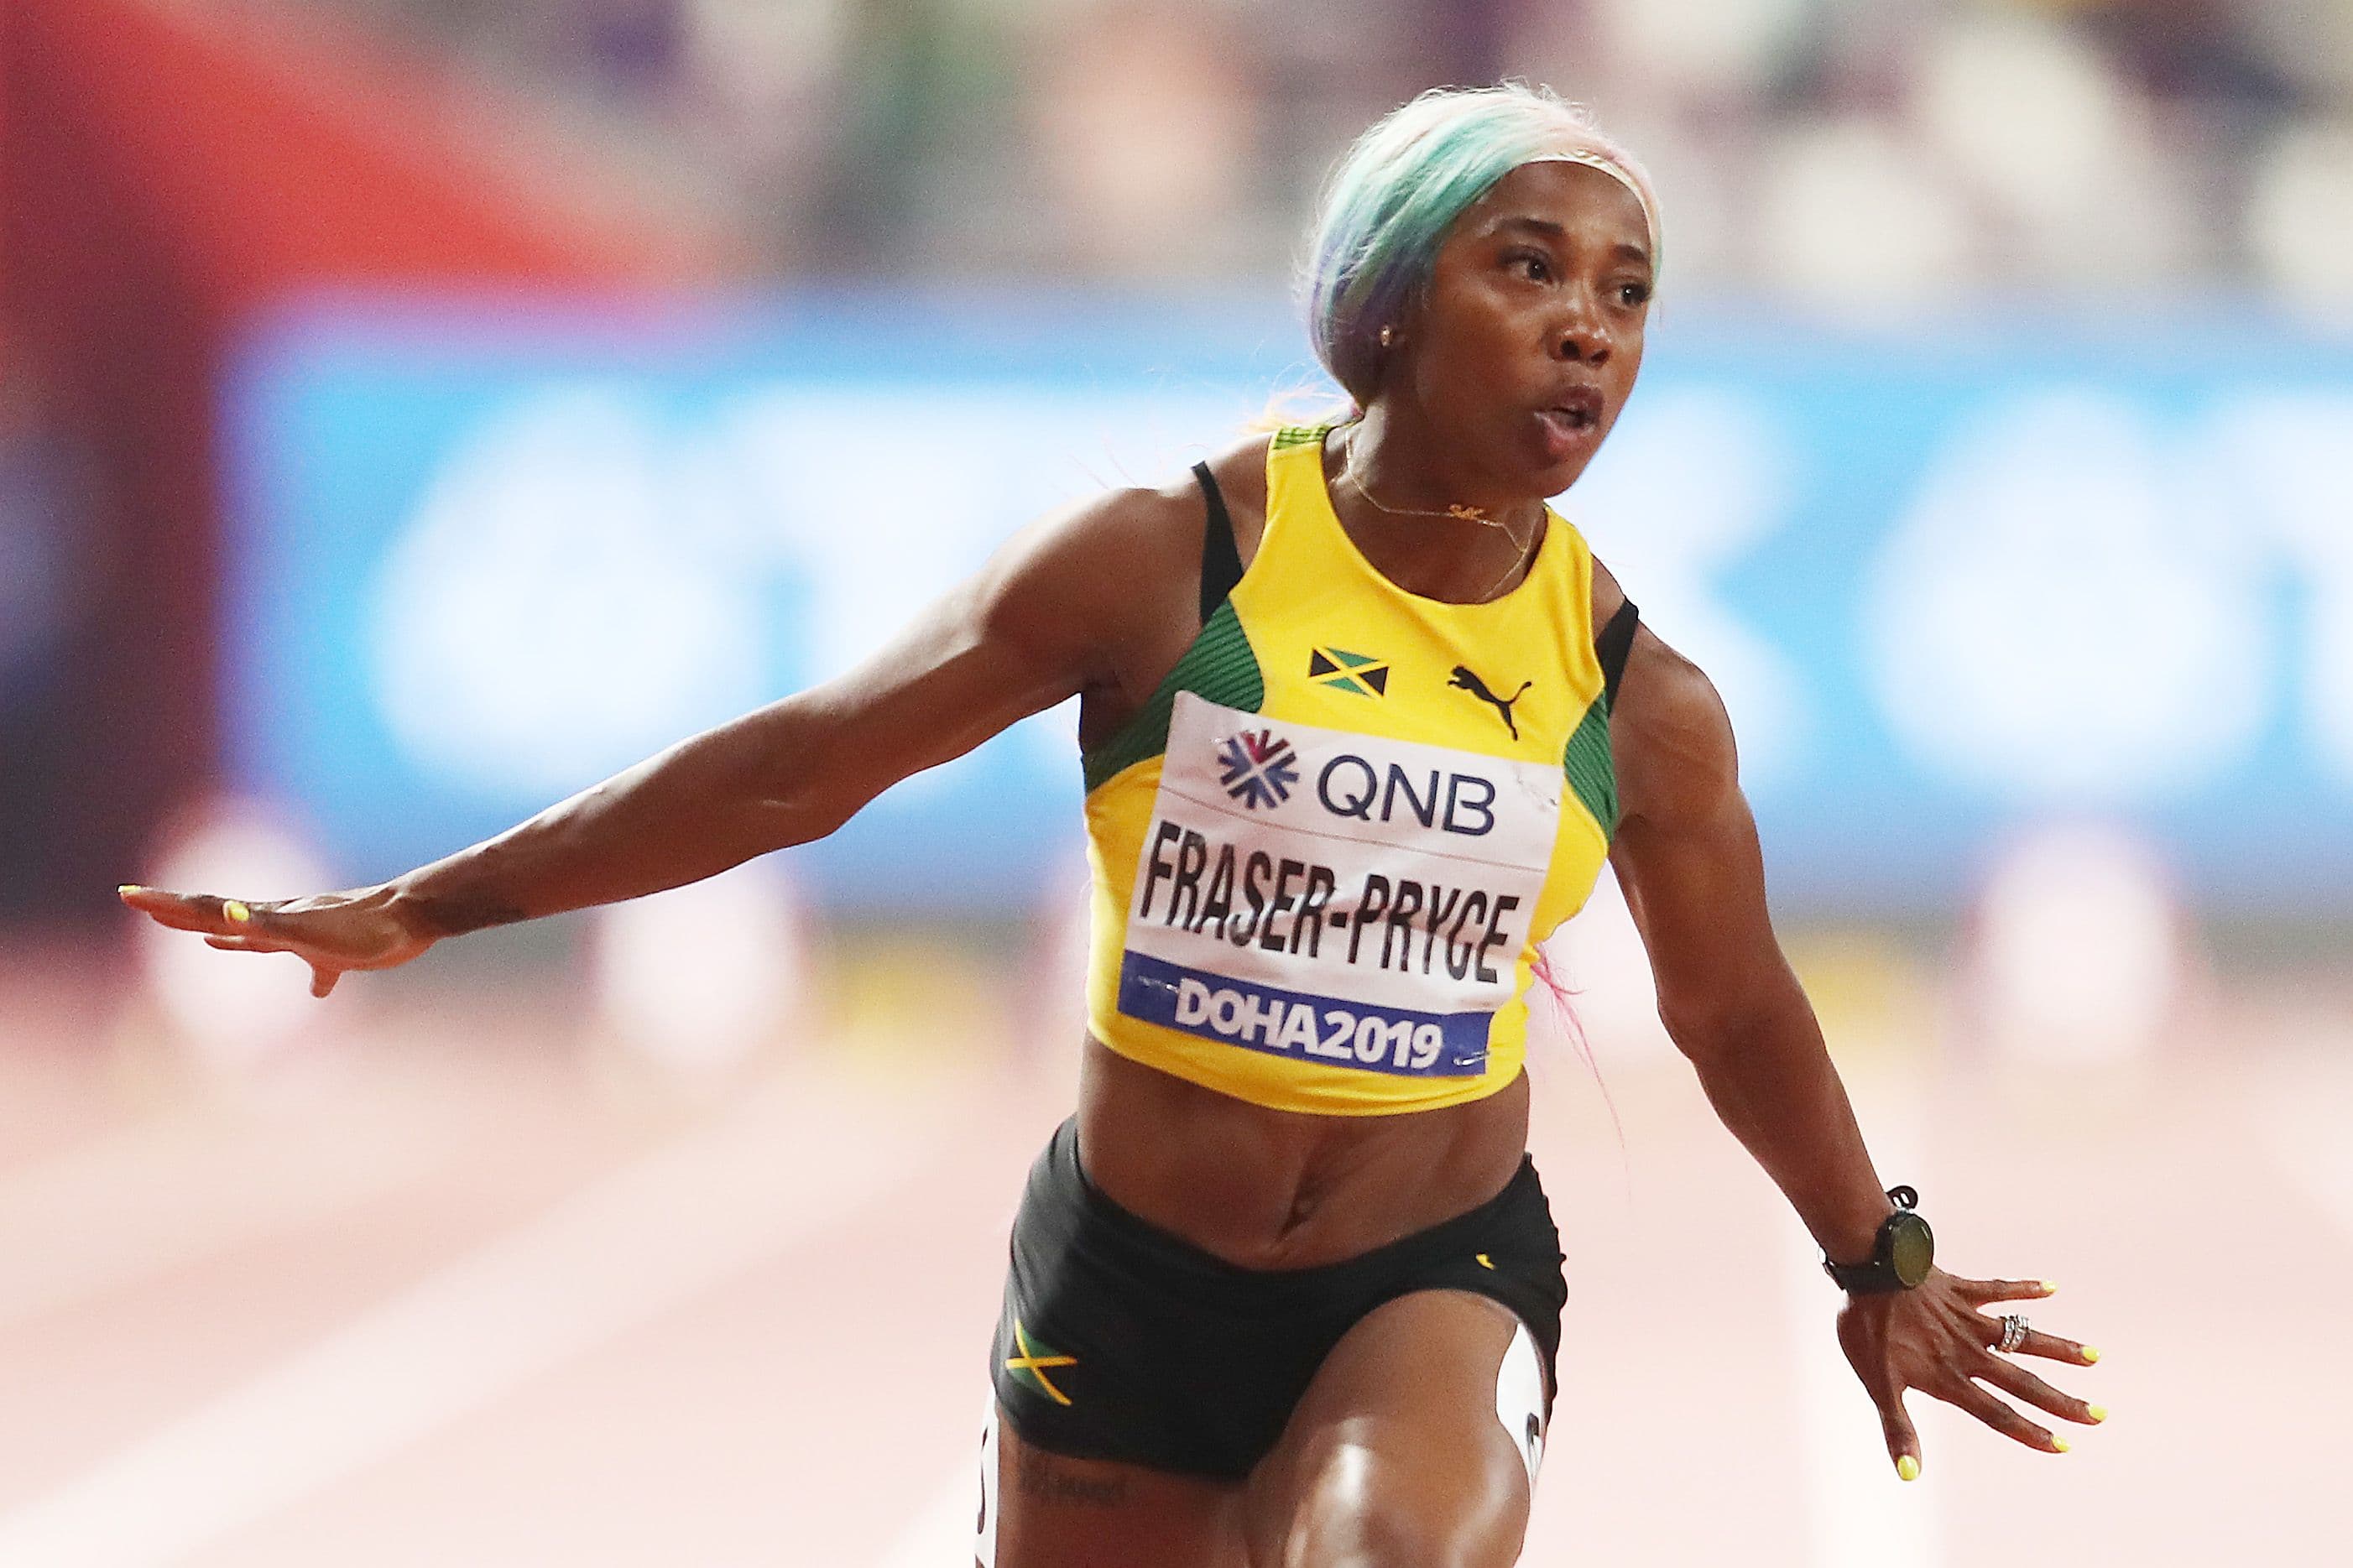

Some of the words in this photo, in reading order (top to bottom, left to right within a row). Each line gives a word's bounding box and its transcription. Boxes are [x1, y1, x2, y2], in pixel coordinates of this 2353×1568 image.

[1317, 755, 1497, 836] QNB
[1140, 820, 1520, 984] FRASER-PRYCE
[1175, 977, 1442, 1069] DOHA2019
